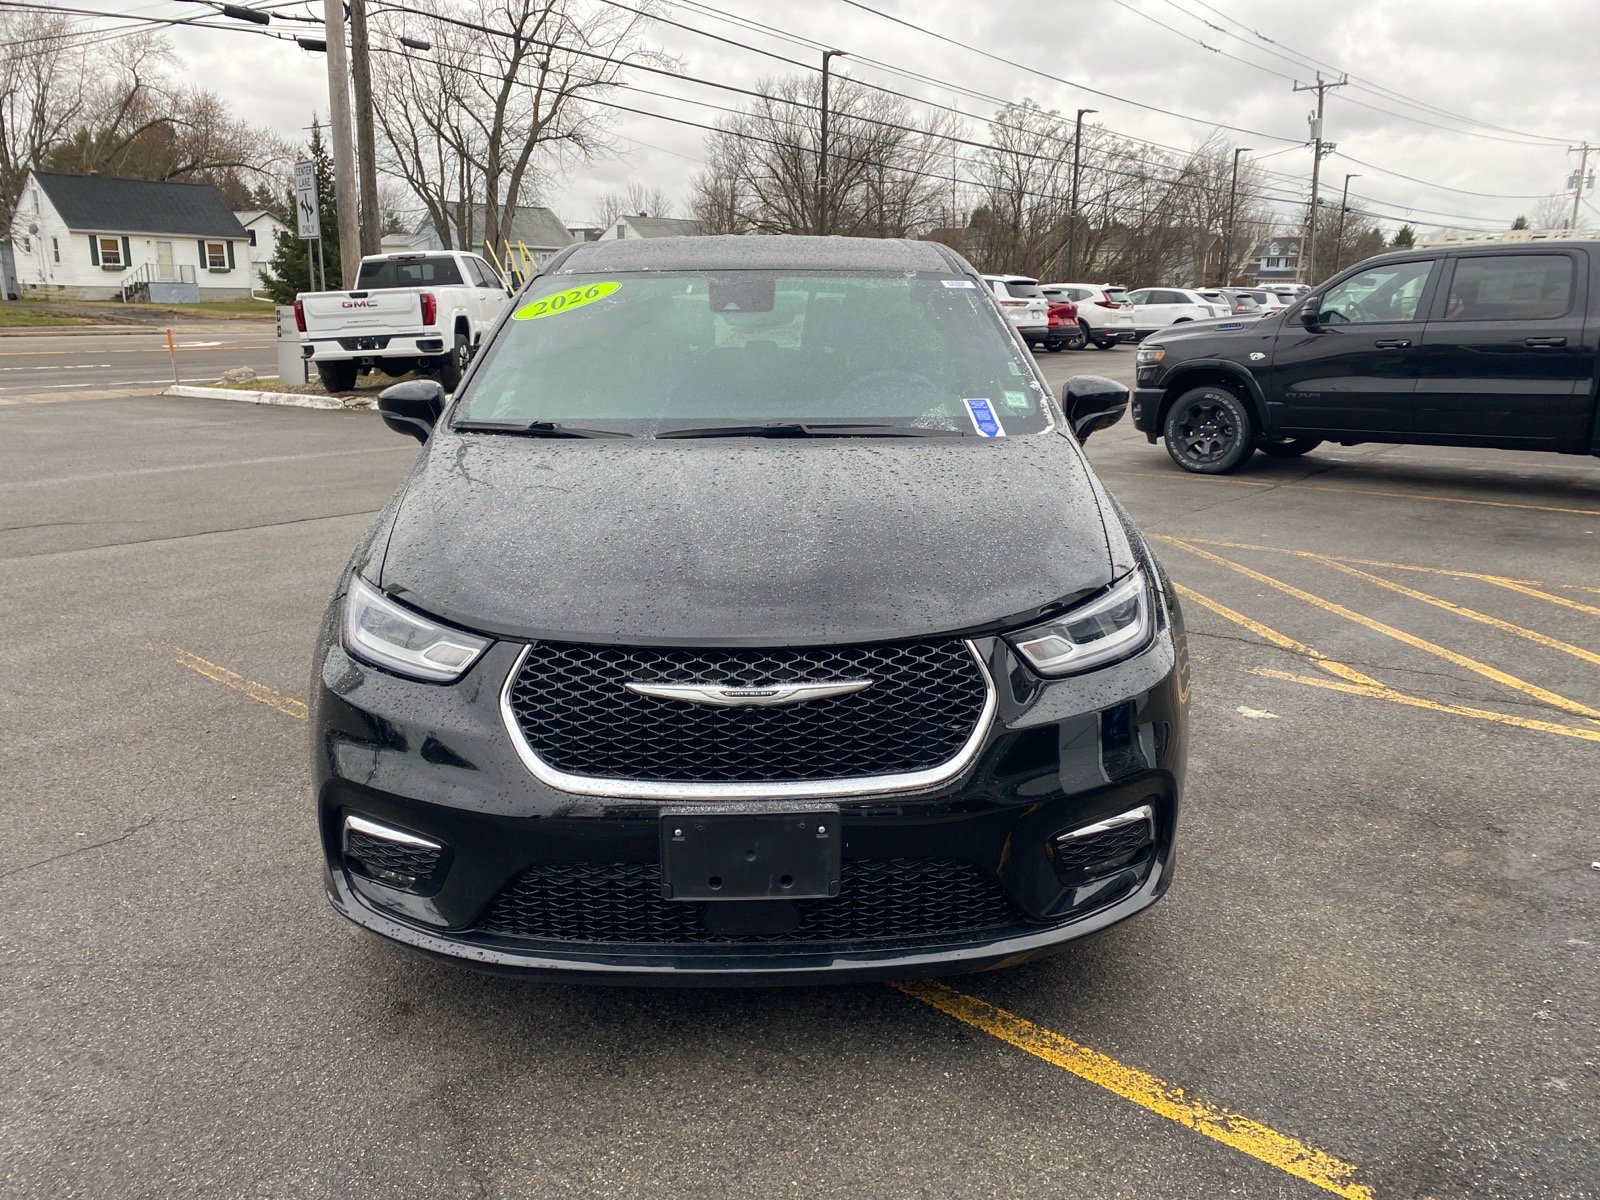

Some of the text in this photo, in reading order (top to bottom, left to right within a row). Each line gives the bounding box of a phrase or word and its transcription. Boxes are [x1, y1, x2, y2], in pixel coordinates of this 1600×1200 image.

[296, 165, 311, 177] CENTER
[298, 177, 311, 188] LANE
[302, 224, 315, 234] ONLY
[342, 300, 378, 308] GMC
[533, 285, 599, 317] 2026
